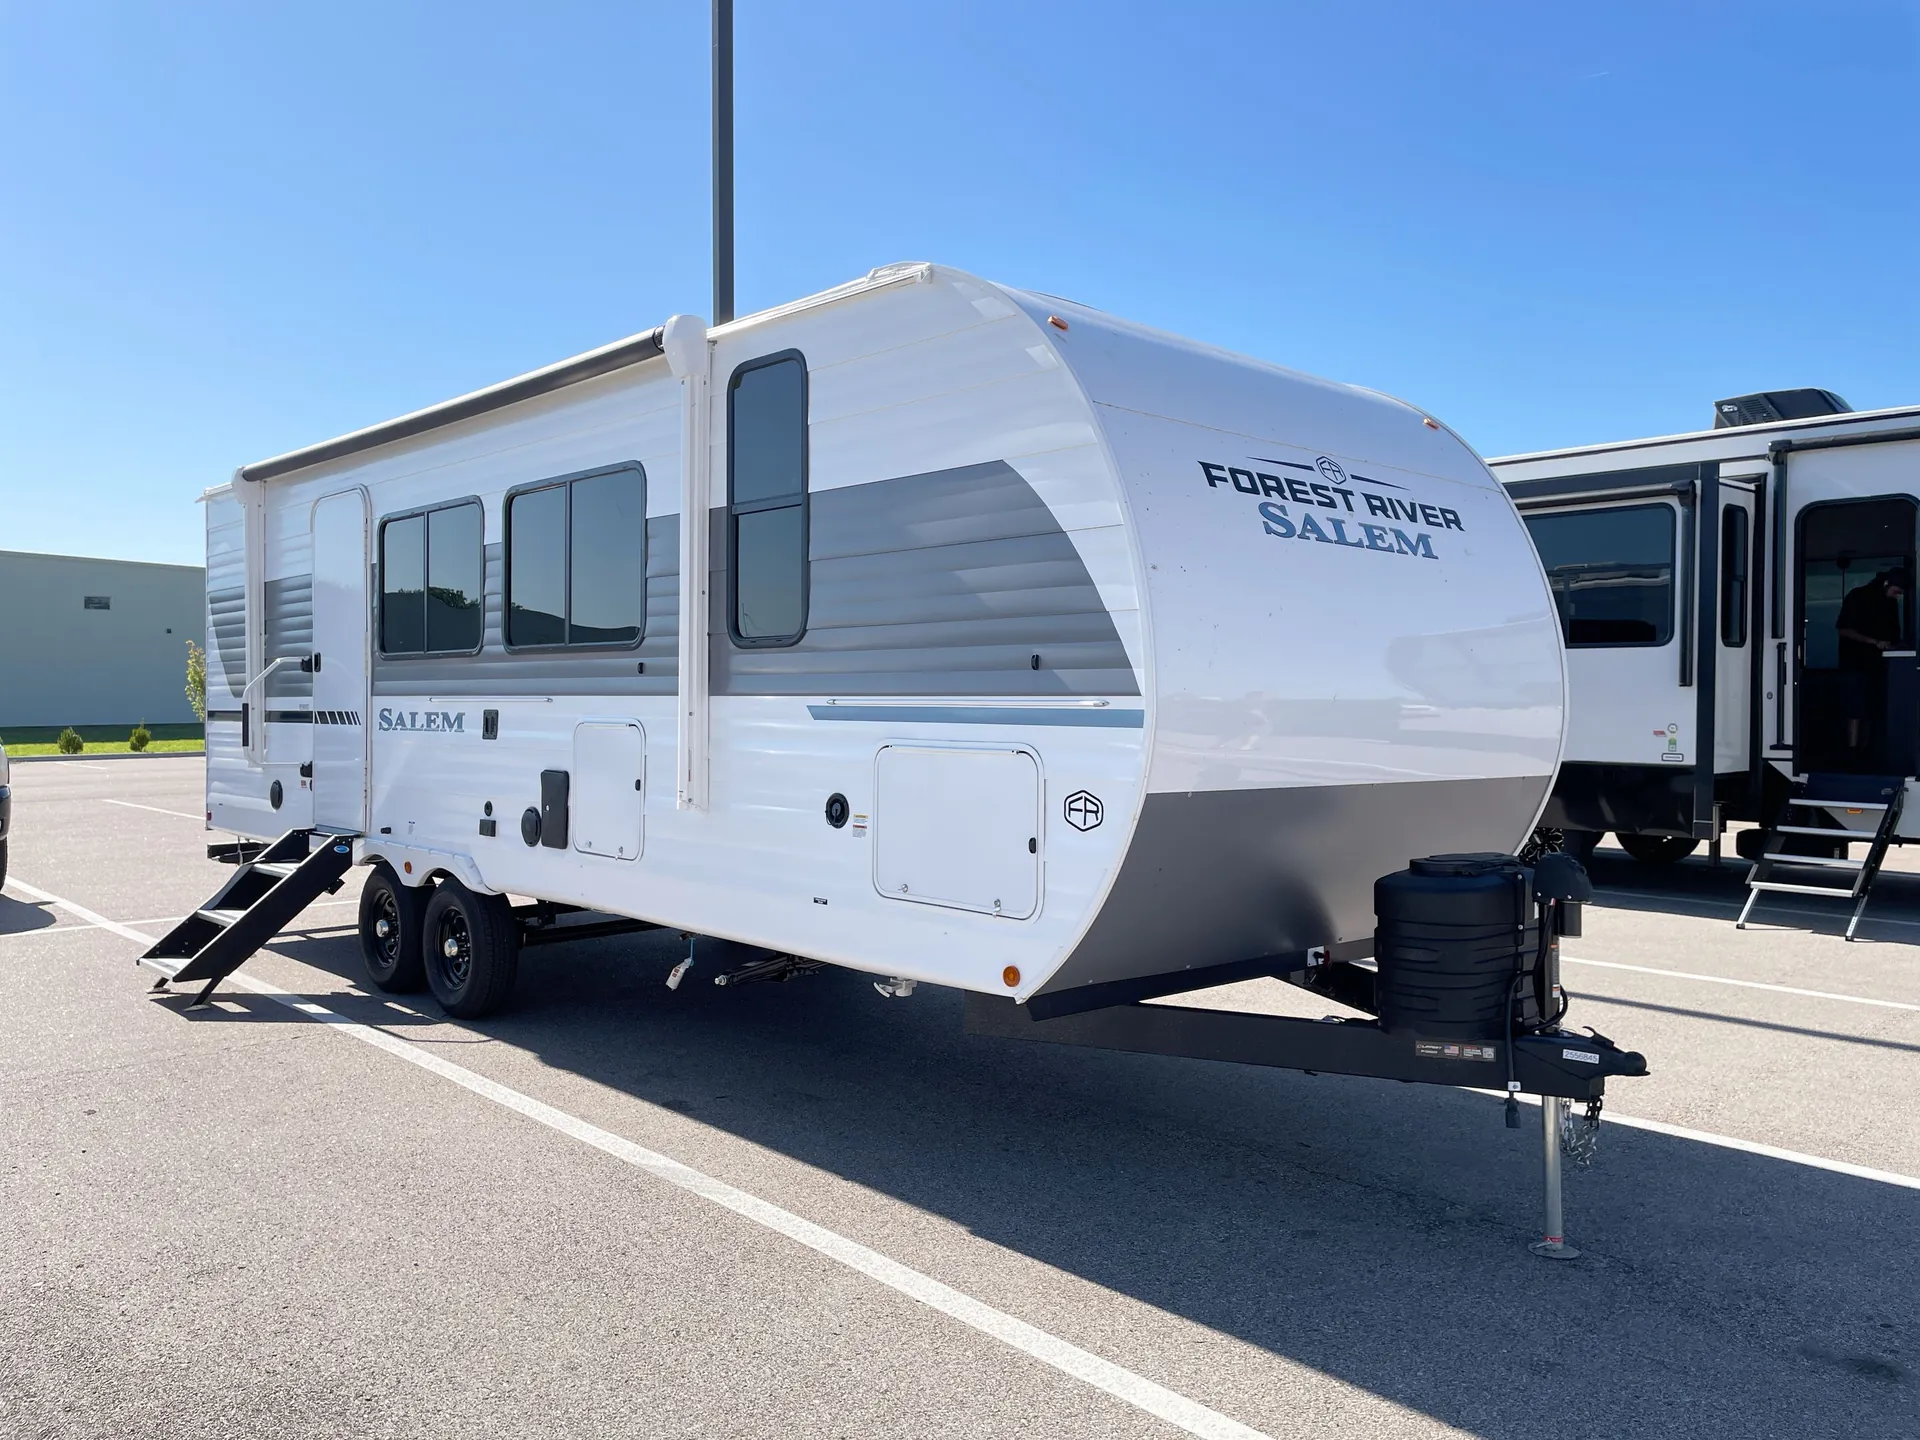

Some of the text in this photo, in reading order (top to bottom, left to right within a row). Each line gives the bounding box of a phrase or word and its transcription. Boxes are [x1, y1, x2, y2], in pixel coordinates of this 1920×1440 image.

[1197, 460, 1465, 532] FOREST RIVER
[1257, 501, 1439, 560] SALEM
[378, 707, 466, 733] SALEM
[1564, 1050, 1598, 1063] 2556845
